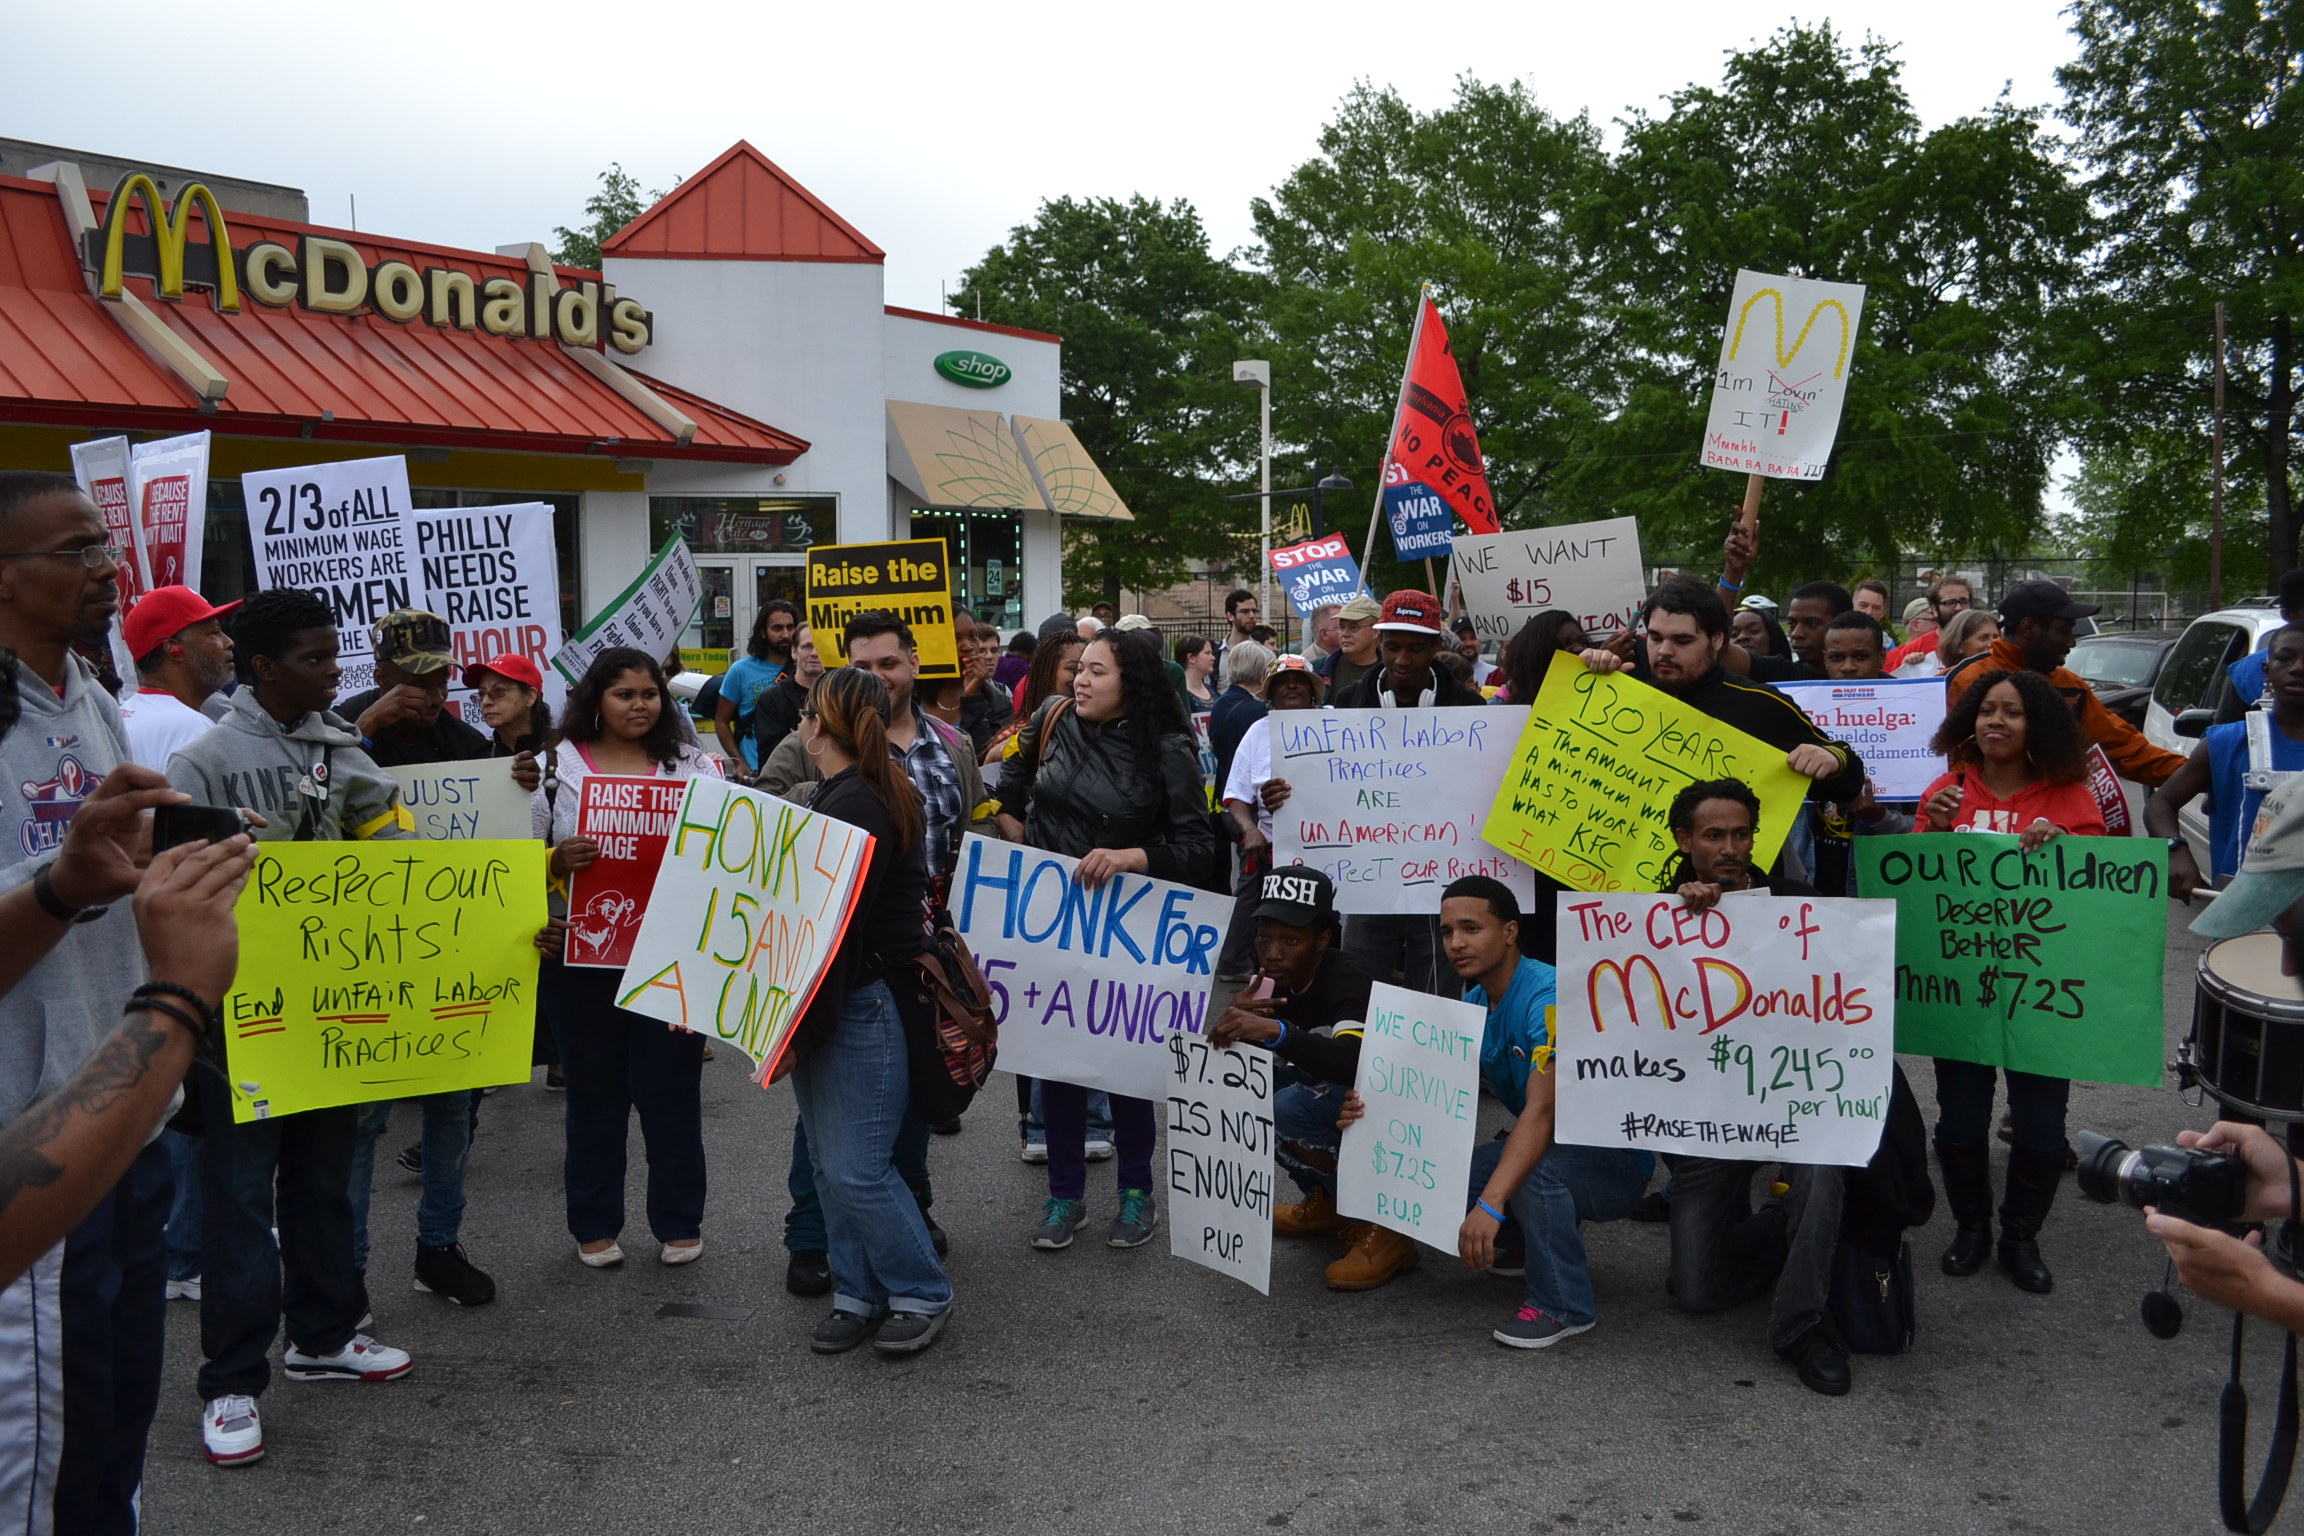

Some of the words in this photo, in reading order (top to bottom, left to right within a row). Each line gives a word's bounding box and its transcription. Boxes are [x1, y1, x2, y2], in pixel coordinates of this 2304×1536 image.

[99, 171, 652, 353] McDonald's
[957, 355, 1007, 383] shop
[1400, 423, 1422, 453] NO
[1425, 453, 1496, 527] PEACE
[1409, 485, 1424, 496] THE
[152, 481, 188, 503] BECAUSE
[1398, 496, 1442, 519] WAR
[161, 502, 186, 523] RENT
[260, 483, 325, 536] 2/3
[328, 500, 349, 529] of
[352, 486, 399, 520] ALL
[1416, 521, 1429, 530] ON
[161, 523, 184, 544] WAIT
[264, 533, 349, 562] MINIMUM
[352, 527, 404, 550] WAGE
[417, 514, 512, 553] PHILLY
[1396, 530, 1452, 551] WORKERS
[267, 555, 364, 587] WORKERS
[370, 551, 407, 576] ARE
[1274, 540, 1342, 567] STOP
[1306, 561, 1324, 571] THE
[1458, 546, 1499, 574] WE
[1524, 537, 1617, 565] WANT
[422, 551, 517, 590] NEEDS
[650, 573, 669, 600] FIGHT
[811, 561, 879, 587] Raise
[887, 557, 937, 582] the
[988, 570, 1000, 584] 24
[1295, 568, 1351, 589] WAR
[446, 585, 531, 624] RAISE
[1320, 585, 1335, 593] ON
[1506, 577, 1552, 605] $15
[624, 613, 645, 640] Union
[637, 602, 651, 620] you
[649, 612, 663, 636] have
[811, 602, 946, 629] Minum
[1395, 607, 1423, 617] Supreme
[1475, 613, 1509, 638] AND
[337, 630, 364, 651] HE
[702, 652, 729, 662] Today
[1573, 671, 1644, 734] 930
[1836, 707, 1916, 731] huelga:
[1826, 729, 1887, 743] Sueldos
[1525, 745, 1539, 765] A
[403, 778, 480, 806] JUST
[588, 783, 644, 808] RAISE
[649, 786, 684, 811] THE
[1356, 789, 1401, 810] ARE
[426, 810, 479, 840] SAY
[586, 808, 675, 837] MINIMUM
[1520, 767, 1553, 798] HAS
[1559, 787, 1578, 809] TO
[1587, 804, 1639, 839] WORK
[1648, 831, 1665, 851] TO
[674, 778, 813, 904] HONK
[814, 819, 854, 921] 4
[1508, 828, 1555, 868] In
[1568, 822, 1621, 869] KFC
[1990, 844, 2158, 900] Children
[959, 840, 1153, 965] HONK
[1261, 875, 1318, 906] FRSH
[300, 907, 462, 970] Rights!
[696, 887, 760, 968] 15
[747, 909, 815, 996] AND
[1567, 901, 1632, 941] The
[1646, 901, 1730, 949] CEO
[1779, 903, 1820, 960] of
[234, 987, 285, 1020] End
[618, 961, 687, 1024] A
[1587, 954, 1873, 1035] McDonalds
[1977, 965, 2085, 1020] $7.25
[1087, 979, 1206, 1045] UNION
[1375, 1007, 1405, 1040] WE
[1412, 1021, 1474, 1061] CAN'T
[1169, 1032, 1267, 1100] $7.25
[1576, 1050, 1686, 1082] makes
[1368, 1056, 1470, 1121] SURVIVE
[1168, 1097, 1211, 1137] IS
[1221, 1109, 1273, 1155] NOT
[1621, 1112, 1800, 1149] #RAISETHEWAGE
[1787, 1099, 1827, 1132] per
[1389, 1119, 1422, 1148] ON
[1372, 1141, 1437, 1190] $7.25
[1170, 1148, 1271, 1220] ENOUGH
